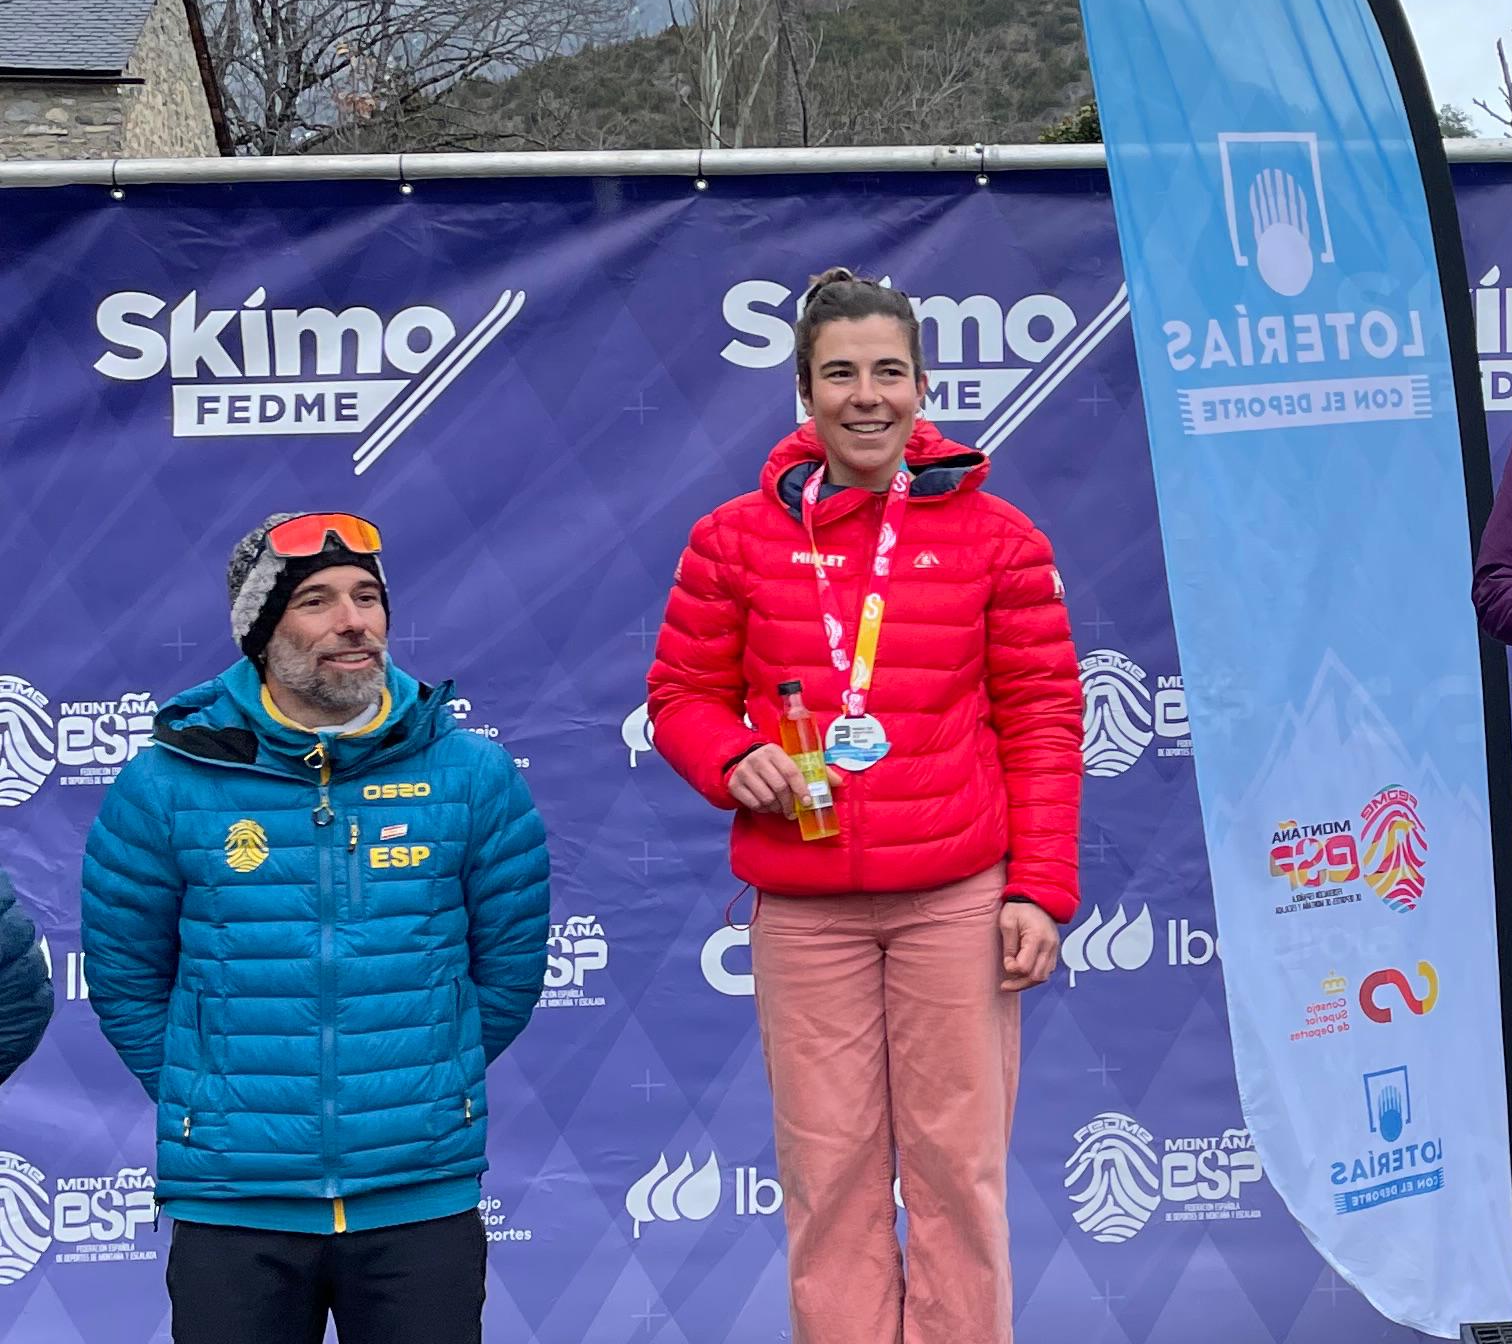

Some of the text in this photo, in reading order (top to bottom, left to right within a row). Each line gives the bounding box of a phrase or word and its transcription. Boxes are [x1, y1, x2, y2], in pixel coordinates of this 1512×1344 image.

[94, 286, 455, 381] Skimo
[720, 276, 1077, 368] Smo
[197, 391, 359, 425] FEDME
[369, 846, 430, 869] ESP
[549, 915, 605, 937] TAÑA
[544, 936, 609, 987] SP
[57, 1167, 156, 1191] MONTAÑA
[486, 1229, 532, 1242] portes
